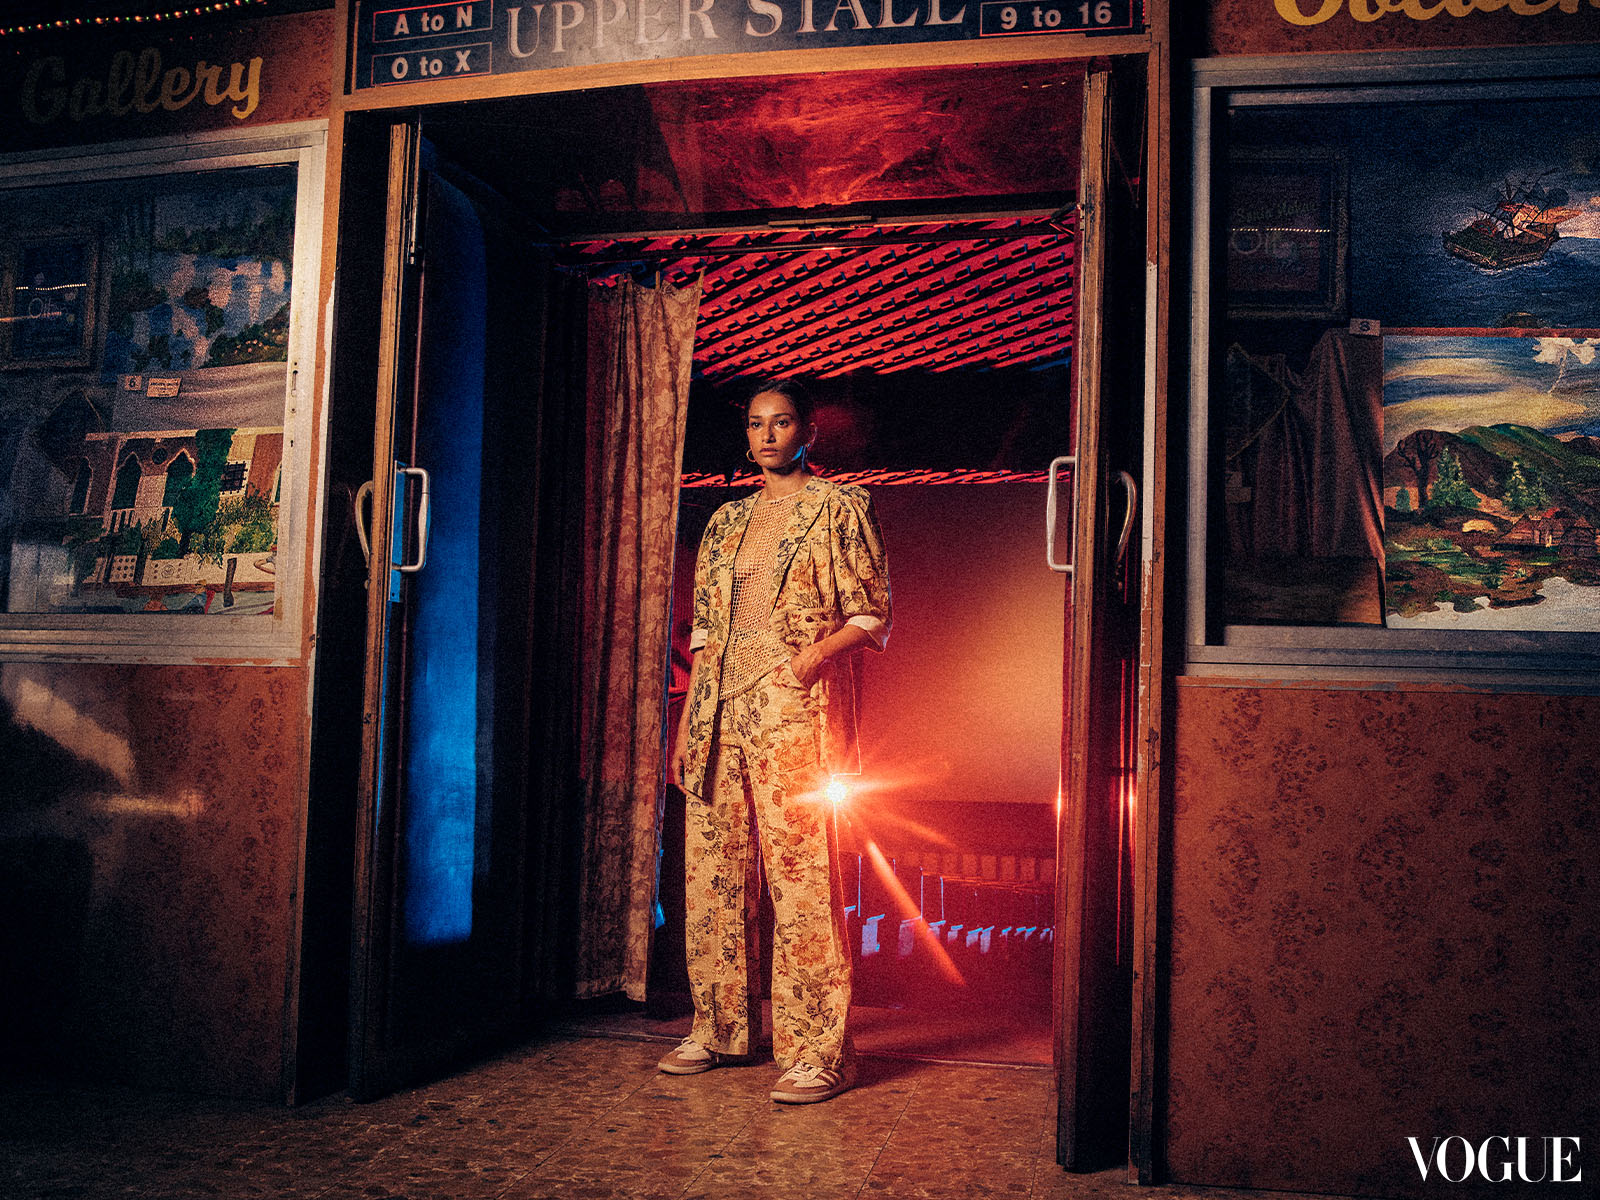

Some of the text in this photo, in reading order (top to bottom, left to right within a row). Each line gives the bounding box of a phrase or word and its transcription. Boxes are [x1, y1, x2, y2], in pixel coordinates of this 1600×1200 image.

[393, 5, 473, 36] A to N
[506, 0, 720, 58] UPPER
[1000, 1, 1112, 30] 9 to 16
[419, 56, 443, 76] to
[454, 49, 471, 73] X
[20, 47, 264, 124] Gallery
